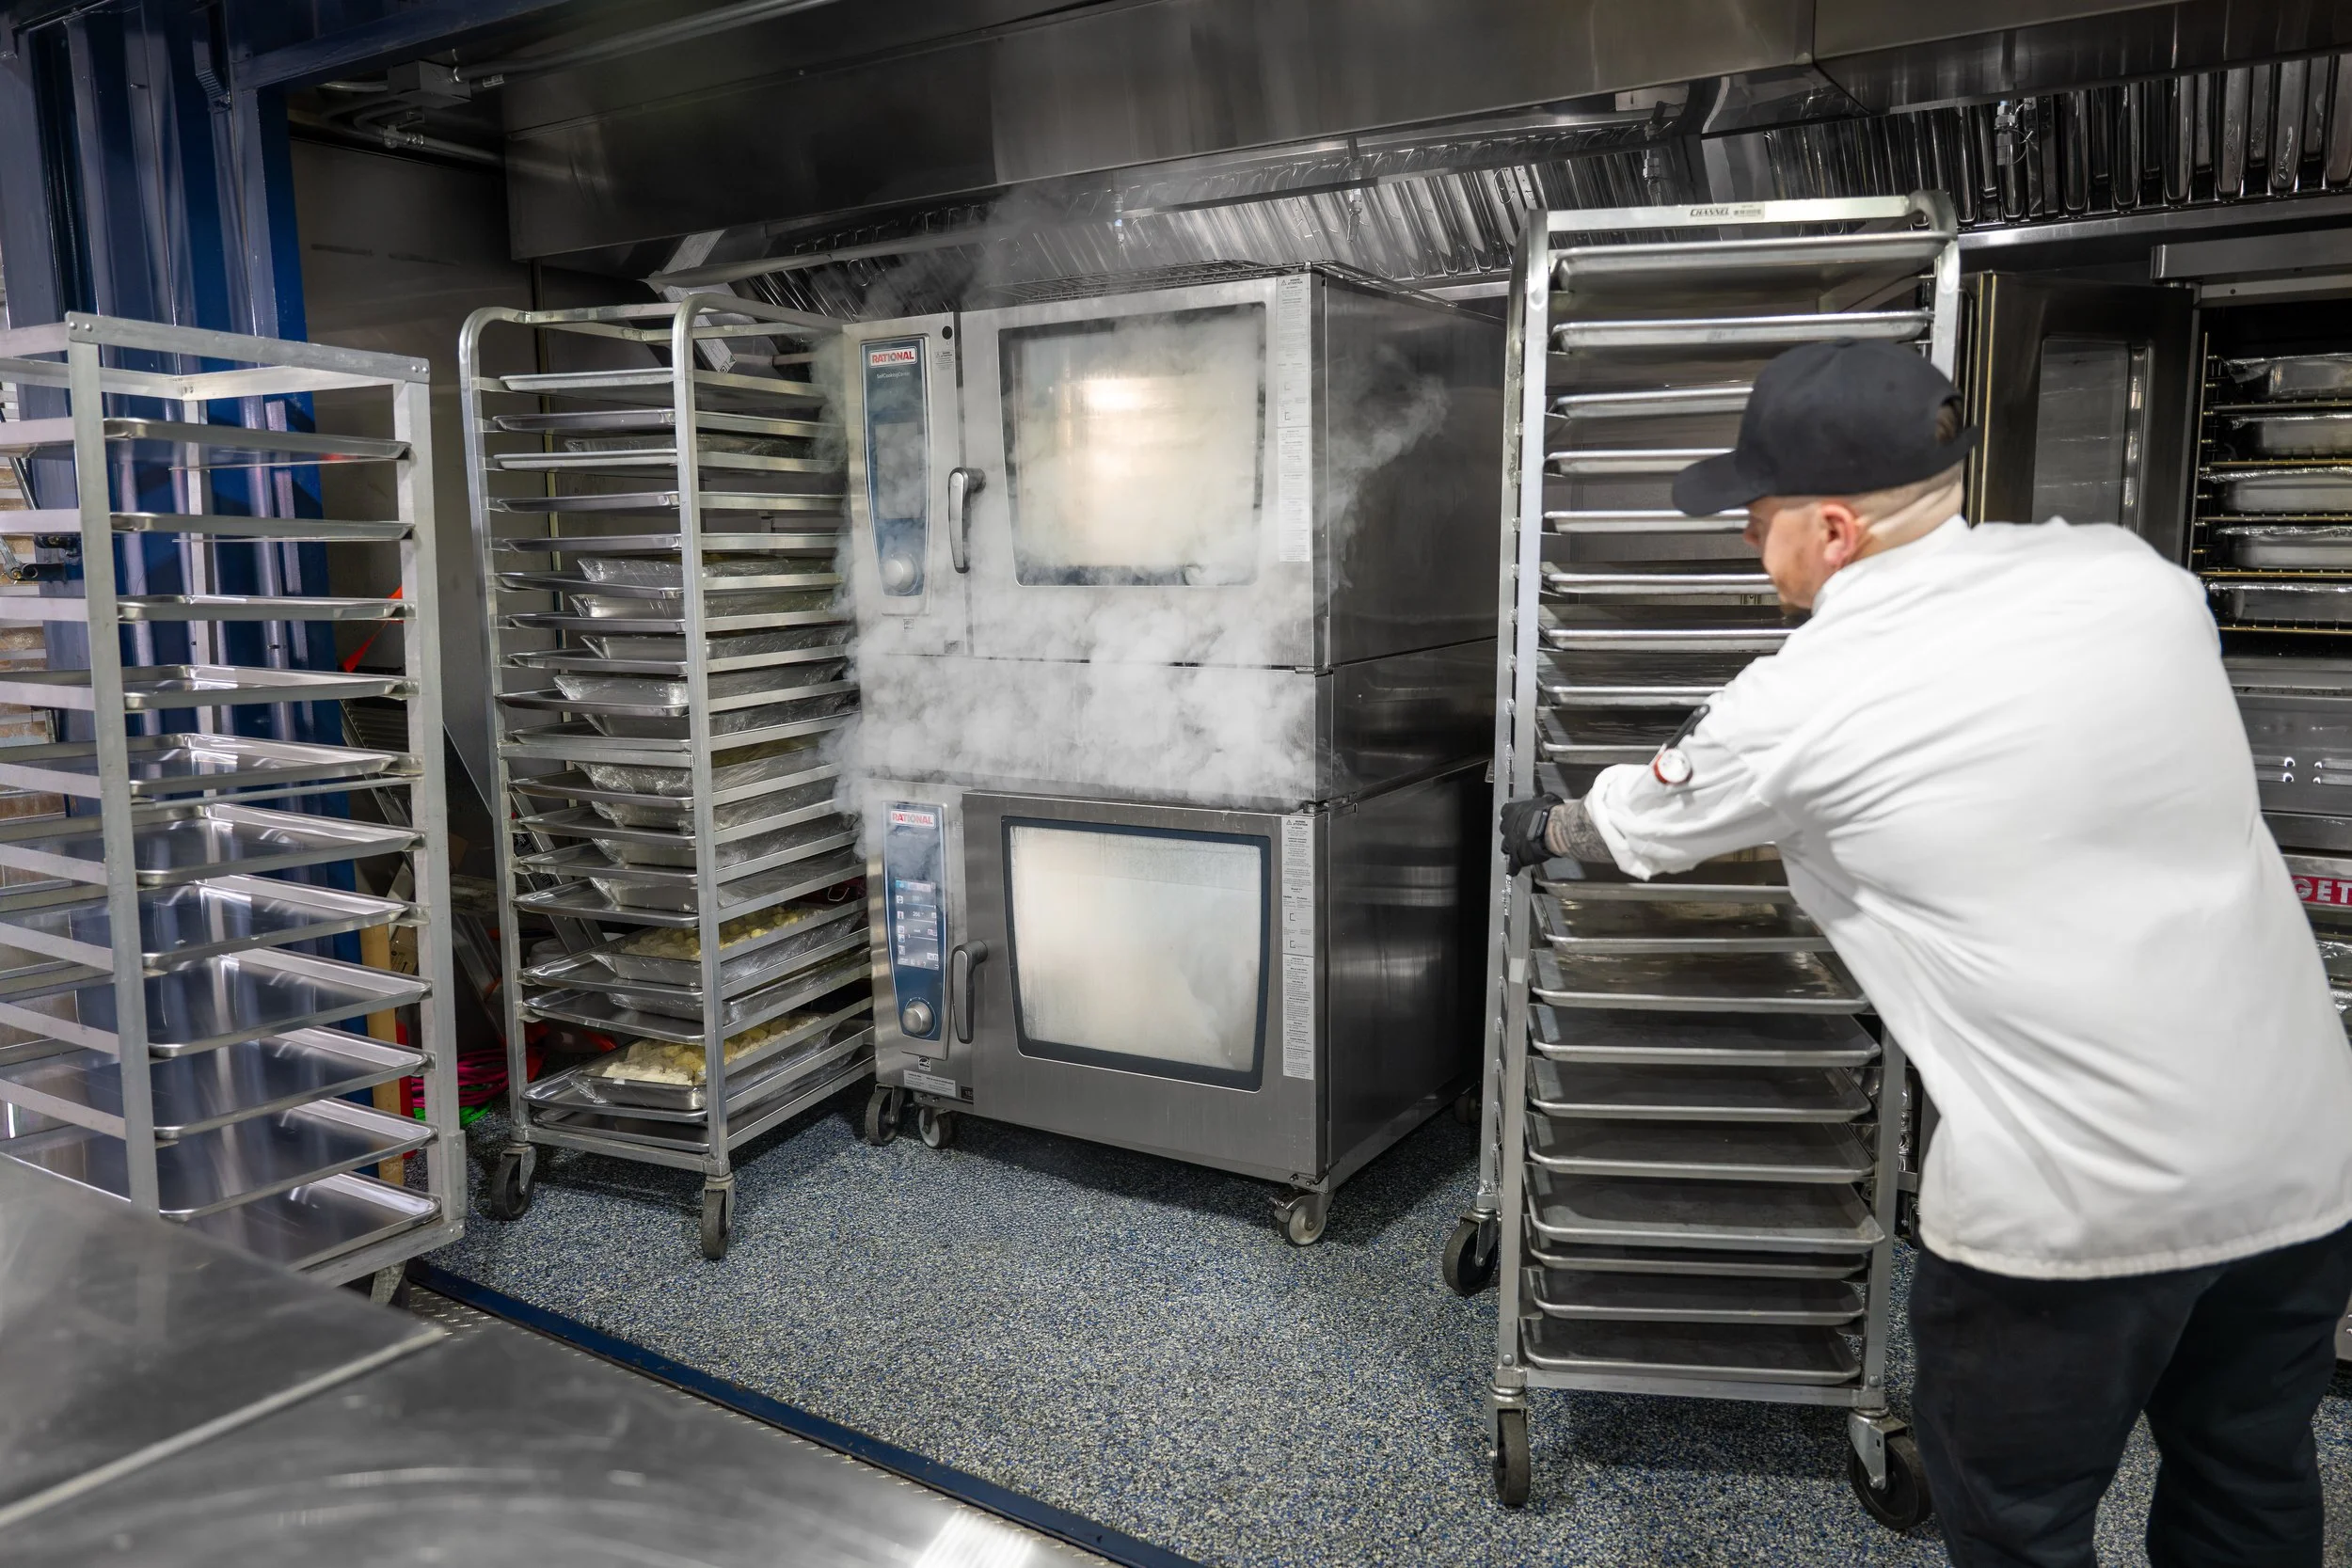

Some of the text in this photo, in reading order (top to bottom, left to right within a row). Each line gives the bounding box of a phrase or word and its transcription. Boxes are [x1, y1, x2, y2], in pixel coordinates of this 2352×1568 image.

[1690, 207, 1729, 217] CHANNEL
[871, 351, 914, 364] RATIONAL
[892, 812, 933, 825] RATIONAL
